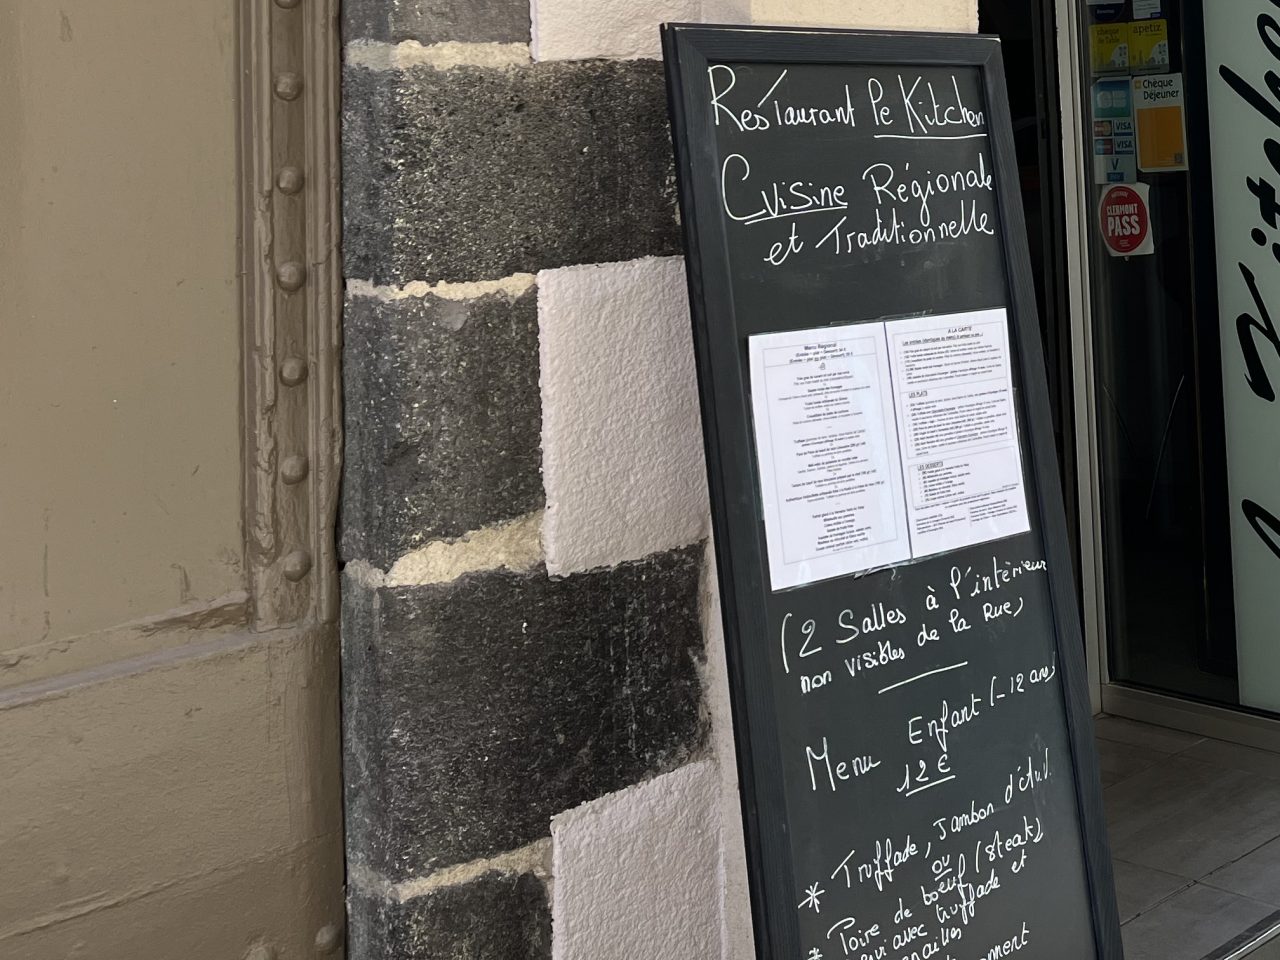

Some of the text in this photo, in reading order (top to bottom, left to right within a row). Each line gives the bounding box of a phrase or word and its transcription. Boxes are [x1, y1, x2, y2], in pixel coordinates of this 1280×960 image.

[898, 74, 985, 134] Kitchen
[1143, 77, 1173, 90] Chèque
[1143, 89, 1179, 101] Déjeuner
[1115, 121, 1132, 131] VISA
[1116, 140, 1132, 149] VISA
[721, 152, 993, 227] Cuisine Régionale
[1107, 203, 1138, 216] CLERMONT
[763, 199, 994, 266] et Traditionnelle
[1108, 217, 1140, 237] PASS
[836, 602, 907, 644] Salles
[925, 585, 940, 611] à
[800, 670, 833, 695] non
[844, 640, 906, 678] visibles
[917, 623, 940, 647] de
[948, 608, 972, 632] la
[805, 736, 882, 792] Menu
[908, 692, 983, 753] Enfant
[932, 800, 995, 841] Jambon
[932, 853, 952, 880] ou
[892, 923, 928, 951] avec
[935, 868, 1001, 926] truffade
[1011, 848, 1027, 875] et
[826, 916, 881, 956] Poire
[894, 897, 913, 925] de
